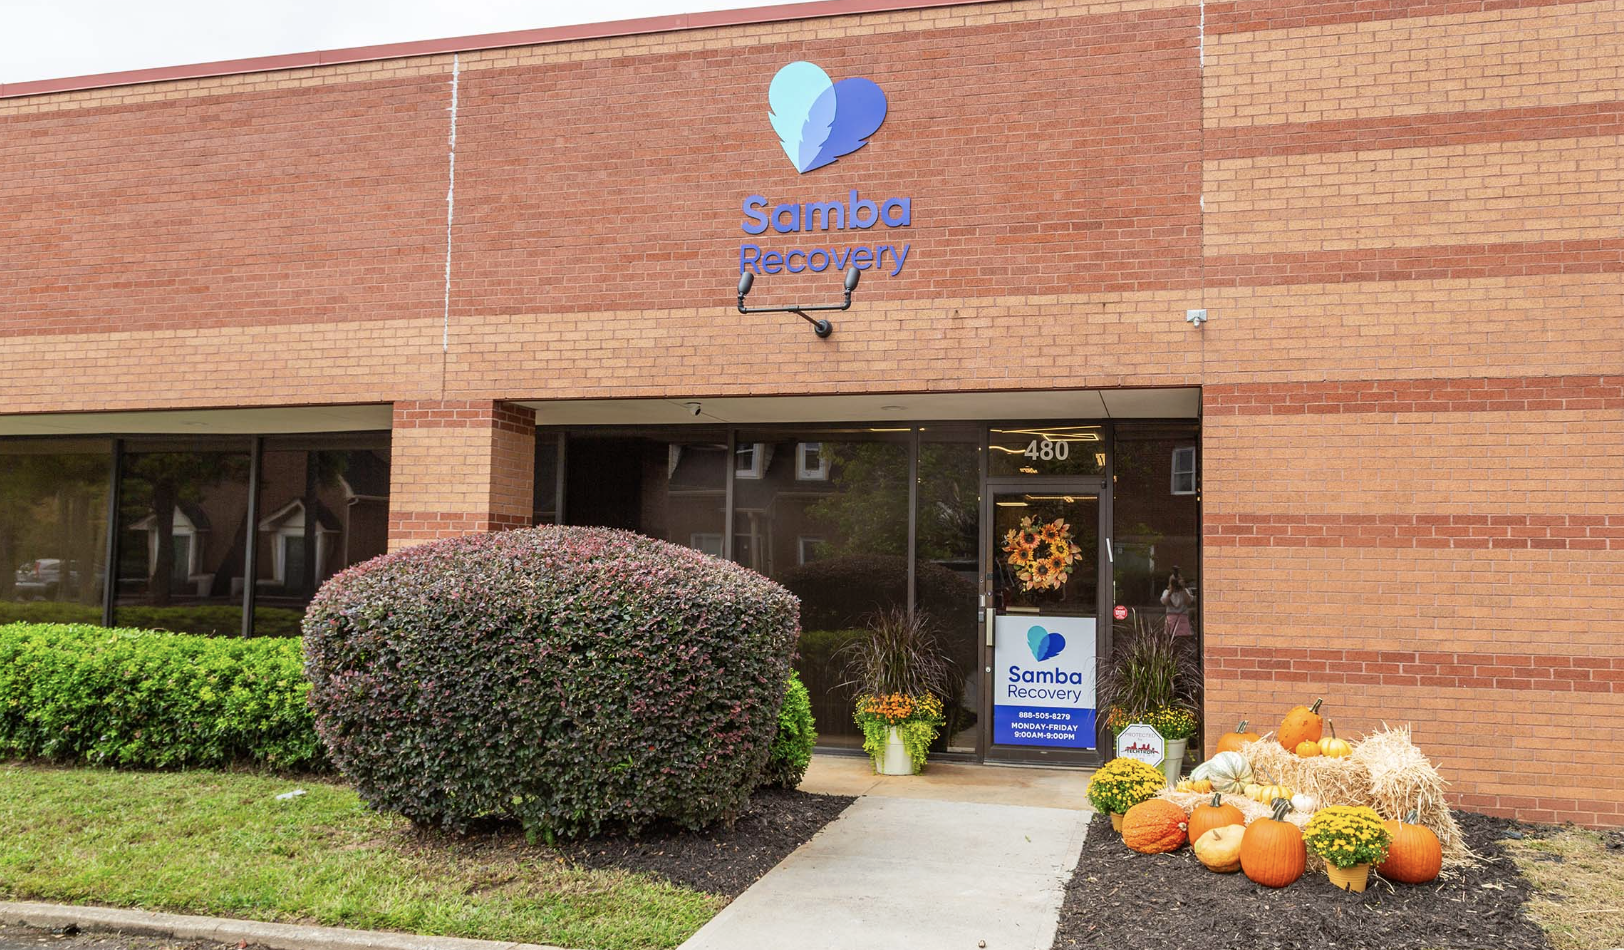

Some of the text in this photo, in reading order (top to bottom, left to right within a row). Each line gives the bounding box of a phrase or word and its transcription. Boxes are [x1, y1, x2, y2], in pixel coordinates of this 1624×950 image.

[741, 189, 911, 234] Samba
[739, 243, 911, 276] Recovery
[1024, 440, 1069, 461] 480
[1008, 665, 1082, 684] Samba
[1007, 684, 1082, 703] Recovery
[1018, 711, 1071, 720] 888-505-8279
[1011, 722, 1078, 732] MONDAY-FRIDAY
[1014, 731, 1075, 740] 9:00AM-9:00PM
